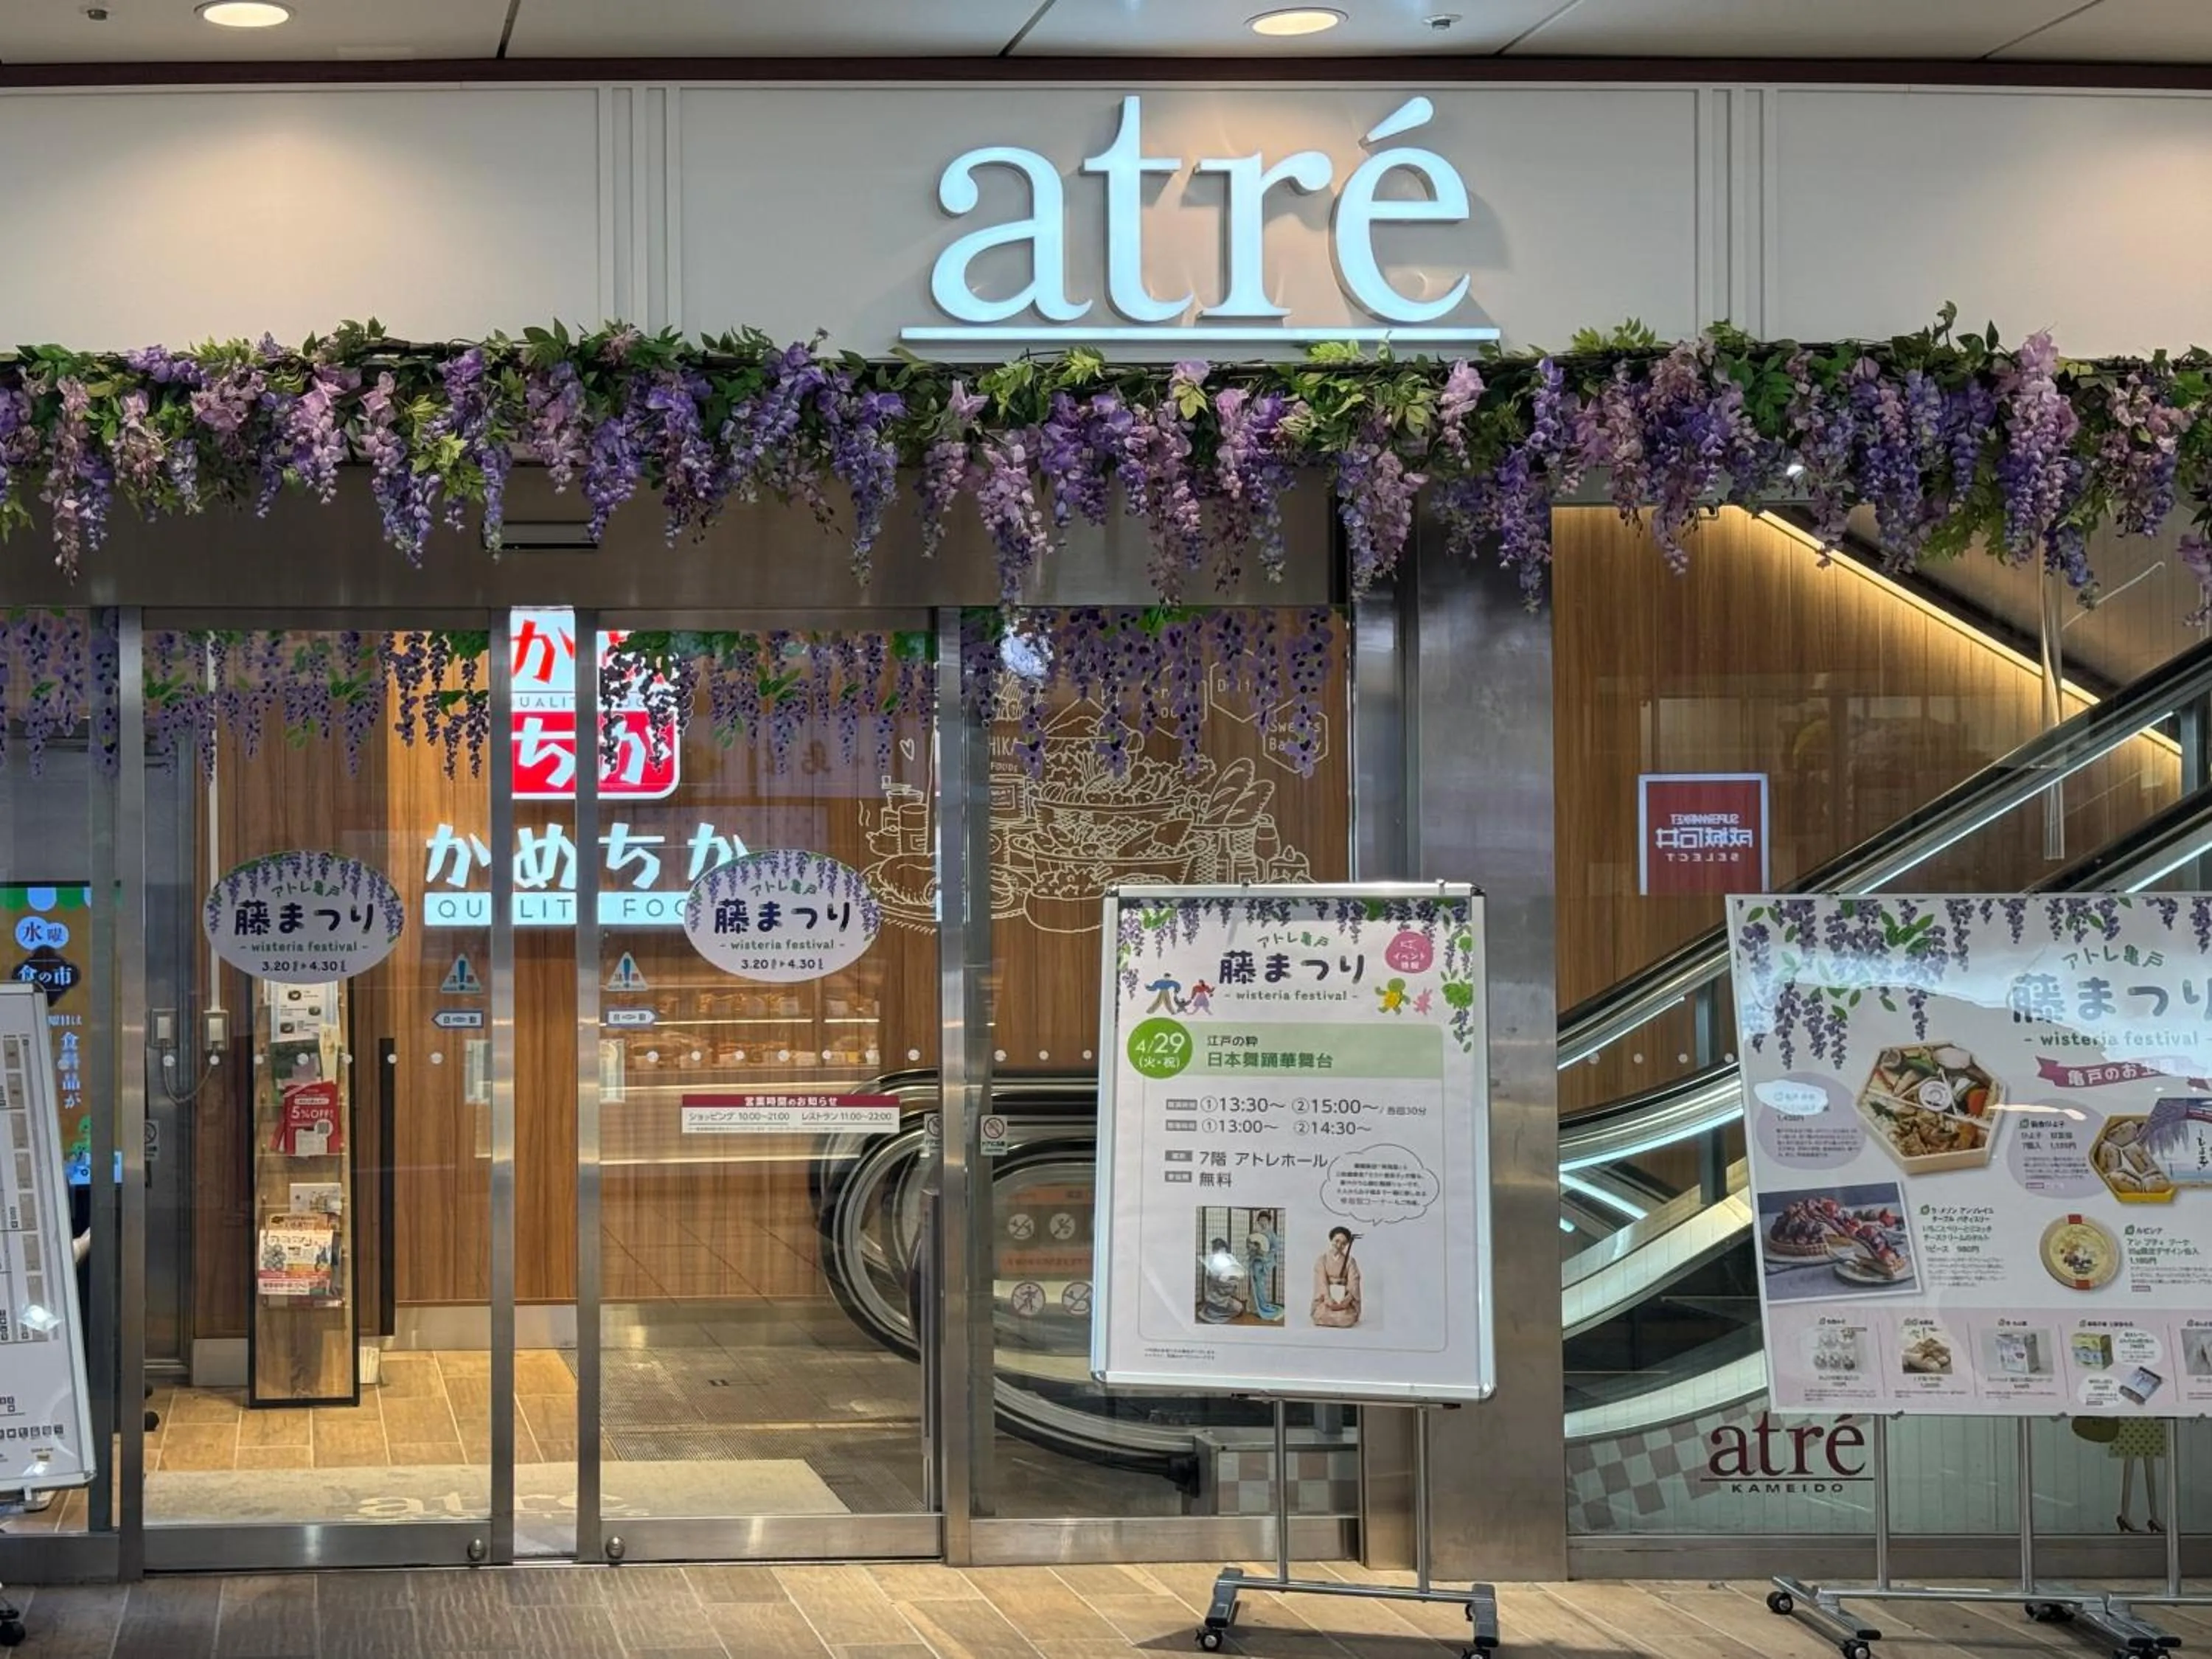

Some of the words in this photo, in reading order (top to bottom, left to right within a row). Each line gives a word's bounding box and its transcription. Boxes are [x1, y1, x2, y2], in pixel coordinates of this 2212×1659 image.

[931, 95, 1470, 322] atré
[1217, 679, 1251, 692] Dli
[438, 899, 572, 918] QULIT
[623, 898, 686, 918] FOO
[714, 898, 850, 934] 藤まつり
[234, 900, 374, 936] 藤まつり
[251, 942, 304, 953] wisteria
[307, 942, 358, 953] festival
[730, 939, 782, 950] wisteria
[786, 939, 835, 950] festival
[740, 959, 769, 970] 3.20
[787, 959, 816, 970] 4.30
[2062, 944, 2165, 970] アトレ亀戸
[262, 961, 290, 972] 3.20
[308, 961, 337, 972] 4.30
[1218, 950, 1366, 985] 藤まつり
[1237, 990, 1290, 1001] wisteria
[1295, 990, 1348, 1001] festival
[1135, 1032, 1186, 1054] 4/29
[1199, 1151, 1227, 1166] 7階
[1234, 1152, 1329, 1169] アトレホール
[1199, 1171, 1233, 1188] 無料
[1708, 1411, 1866, 1476] atré
[1732, 1483, 1844, 1494] KAMEIDO
